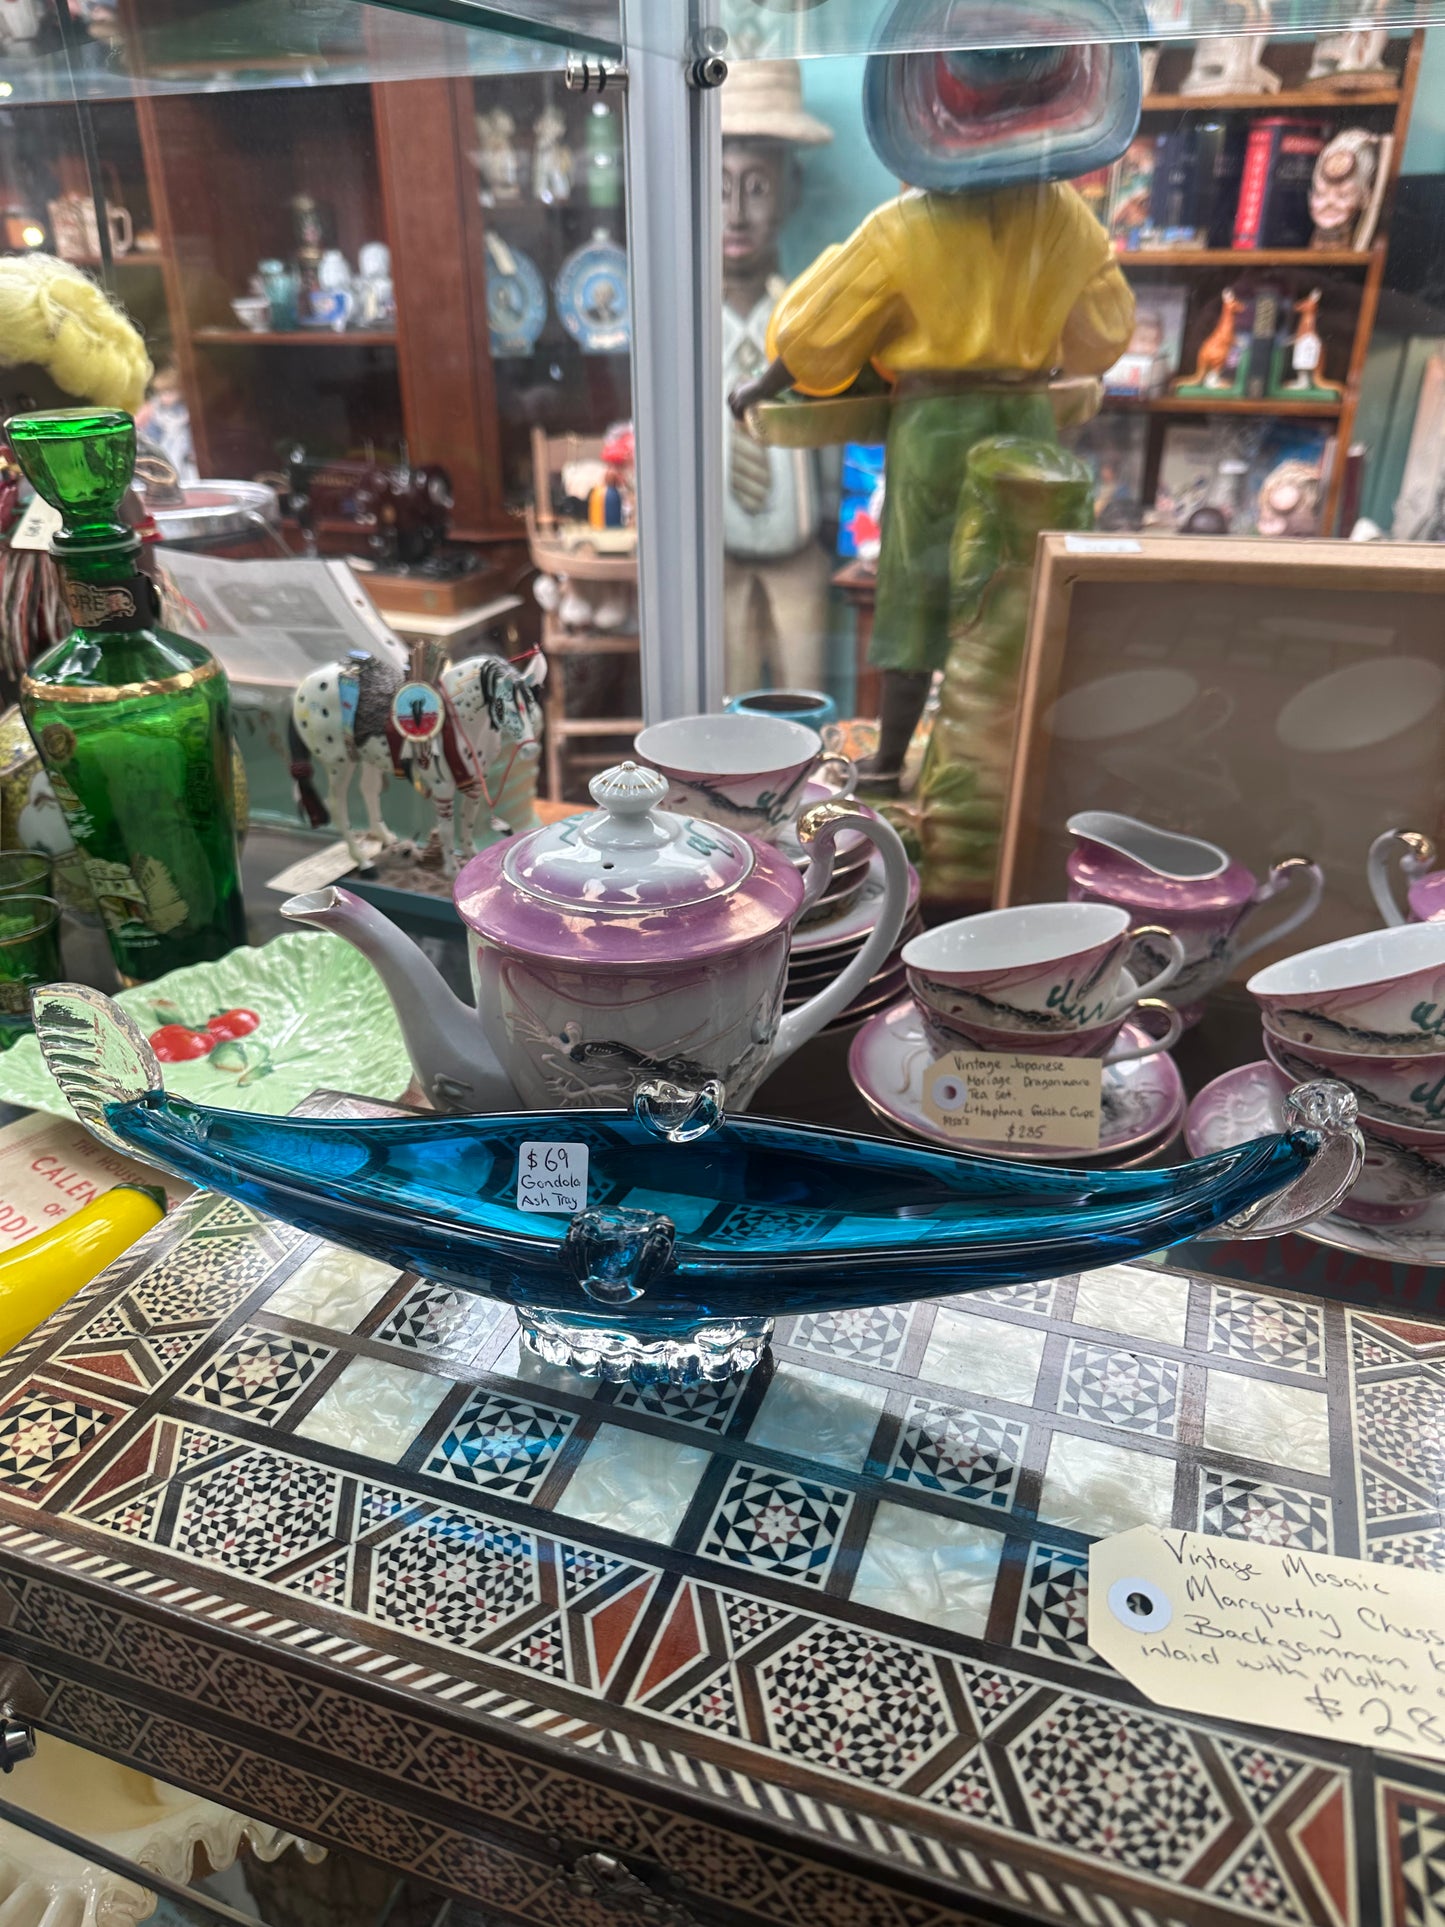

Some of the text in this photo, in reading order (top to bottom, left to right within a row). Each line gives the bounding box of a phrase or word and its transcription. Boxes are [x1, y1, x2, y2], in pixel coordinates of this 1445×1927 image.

[953, 1056, 1065, 1075] Vintage Japanese
[967, 1074, 1090, 1091] Moriage Dragonware
[968, 1088, 989, 1101] Tea
[963, 1102, 1023, 1119] Lithophane
[1069, 1105, 1095, 1119] Cups
[72, 1138, 99, 1157] THE
[527, 1147, 569, 1172] $69
[31, 1155, 98, 1208] CALEN
[520, 1173, 581, 1190] Gondola
[43, 1203, 67, 1217] OF
[521, 1192, 578, 1211] Ash Tray
[0, 1205, 39, 1241] DDI
[1163, 1532, 1391, 1595] Vintage Mosaic
[1186, 1574, 1445, 1646] Marquetry Chess
[1141, 1640, 1420, 1696] inlaid with Mother
